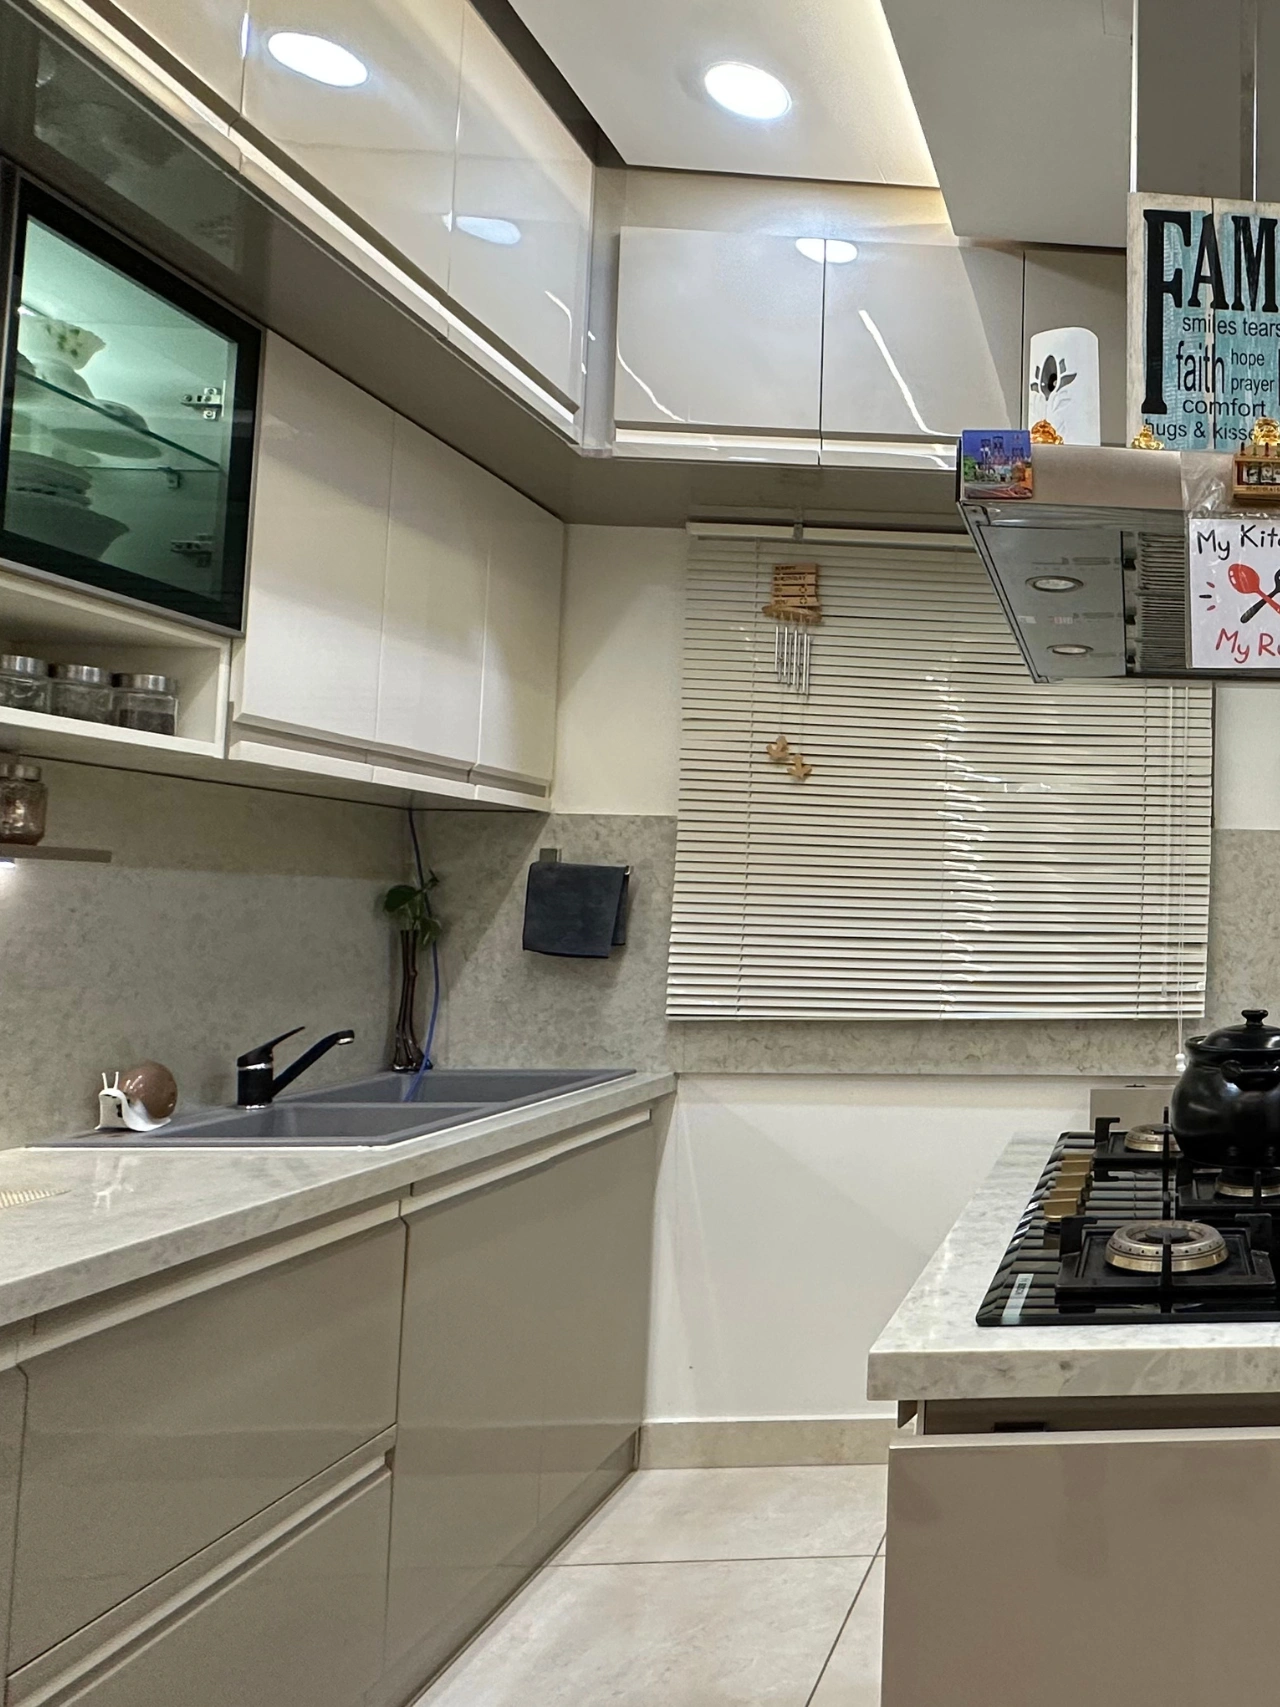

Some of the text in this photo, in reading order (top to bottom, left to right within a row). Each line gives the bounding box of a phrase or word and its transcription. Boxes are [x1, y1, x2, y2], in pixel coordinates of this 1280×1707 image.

[1182, 314, 1237, 336] smiles
[1176, 340, 1225, 394] faith
[1231, 348, 1265, 367] hope
[1231, 376, 1275, 395] prayer
[1182, 398, 1267, 417] comfort
[1193, 421, 1206, 438] &
[1197, 529, 1231, 561] My
[1215, 628, 1250, 664] My
